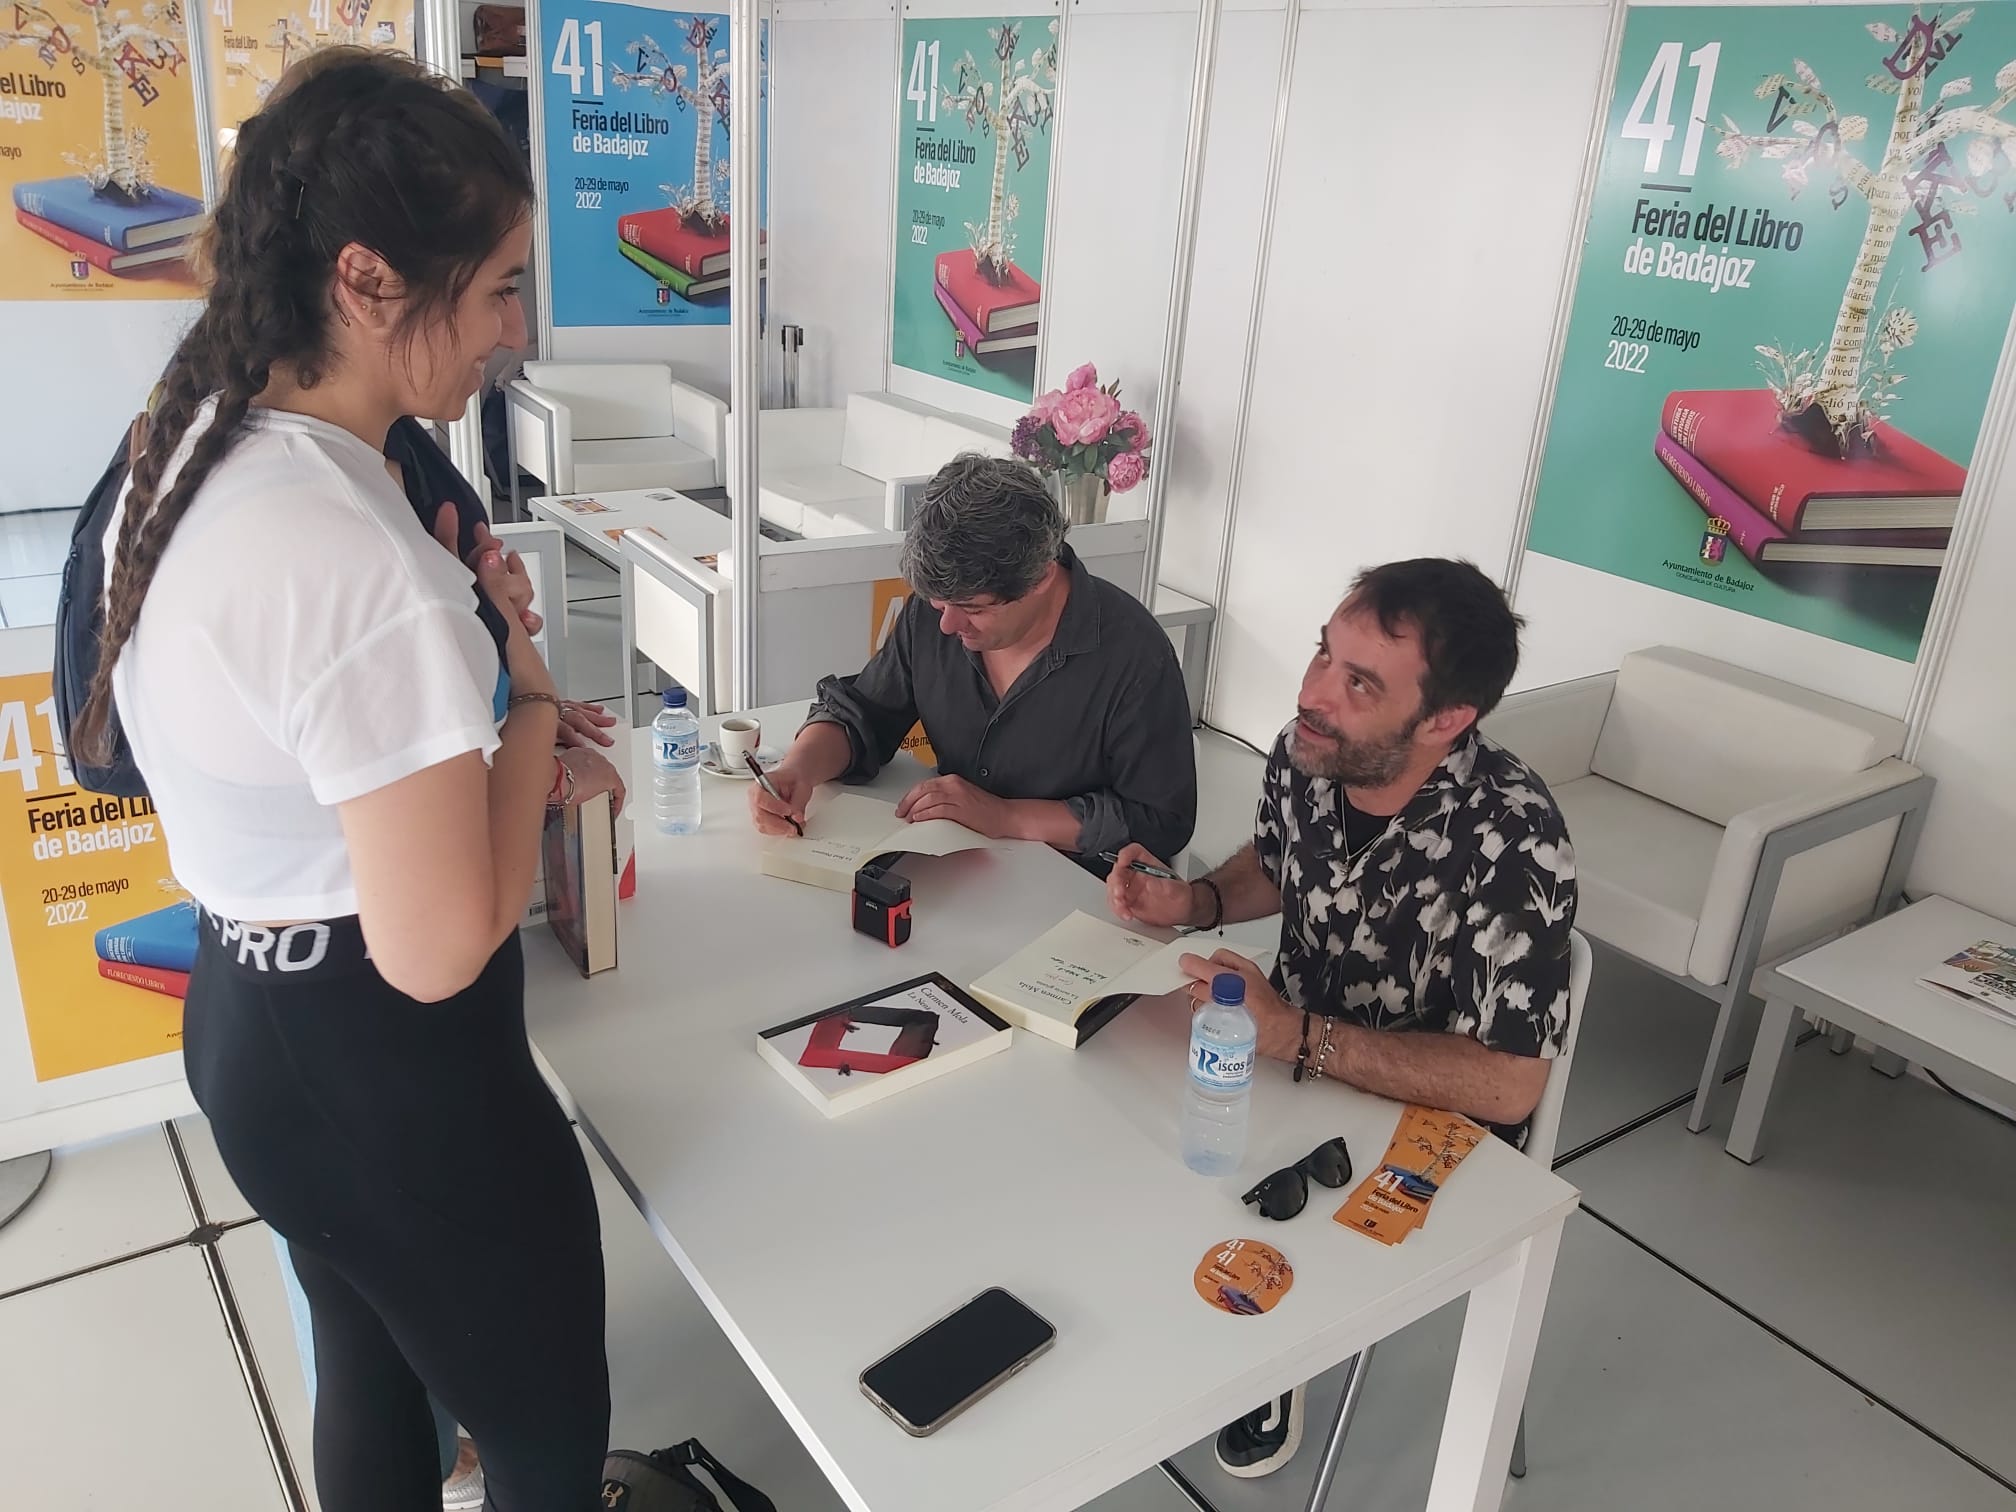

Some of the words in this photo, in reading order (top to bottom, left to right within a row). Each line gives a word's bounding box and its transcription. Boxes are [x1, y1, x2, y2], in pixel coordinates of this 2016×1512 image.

[552, 18, 604, 96] 41
[19, 74, 67, 99] Libro
[906, 40, 940, 122] 41
[572, 108, 608, 132] Feria
[610, 110, 632, 133] del
[634, 112, 669, 136] Libro
[1621, 41, 1722, 176] 41
[572, 131, 592, 153] de
[593, 132, 649, 160] Badajoz
[914, 136, 937, 160] Feria
[937, 138, 952, 162] del
[952, 139, 976, 165] Libro
[574, 176, 597, 191] 20-29
[597, 177, 608, 192] de
[607, 179, 629, 195] mayo
[913, 161, 925, 184] de
[925, 162, 961, 193] Badajoz
[575, 191, 602, 209] 2022
[911, 225, 928, 245] 2022
[1631, 198, 1692, 240] Feria
[1693, 203, 1737, 244] del
[1735, 208, 1804, 252] Libro
[1623, 236, 1656, 276] de
[1655, 241, 1756, 293] Badajoz
[1611, 315, 1647, 340] 20-29
[1646, 320, 1664, 344] de
[1663, 326, 1701, 353] mayo
[1604, 339, 1650, 374] 2022
[1662, 559, 1713, 580] Ayuntamiento
[1714, 573, 1724, 583] de
[1726, 576, 1755, 592] Badajoz
[910, 736, 920, 748] de
[28, 802, 87, 834] Feria
[90, 796, 126, 823] del
[32, 833, 63, 862] de
[65, 821, 157, 854] Badajoz
[41, 884, 78, 905] 20-29
[78, 881, 95, 898] de
[94, 878, 130, 896] mayo
[45, 900, 89, 927] 2022
[220, 917, 331, 972] PRO
[1018, 981, 1039, 995] Mola
[1040, 988, 1073, 1006] Carmen
[920, 987, 949, 1011] Carmen
[947, 1008, 969, 1025] Mola
[1374, 1169, 1405, 1193] 41
[1371, 1188, 1390, 1202] Feria
[1389, 1194, 1402, 1206] del
[1399, 1198, 1419, 1214] Libro
[1216, 1250, 1237, 1267] 41
[1225, 1239, 1246, 1251] 41
